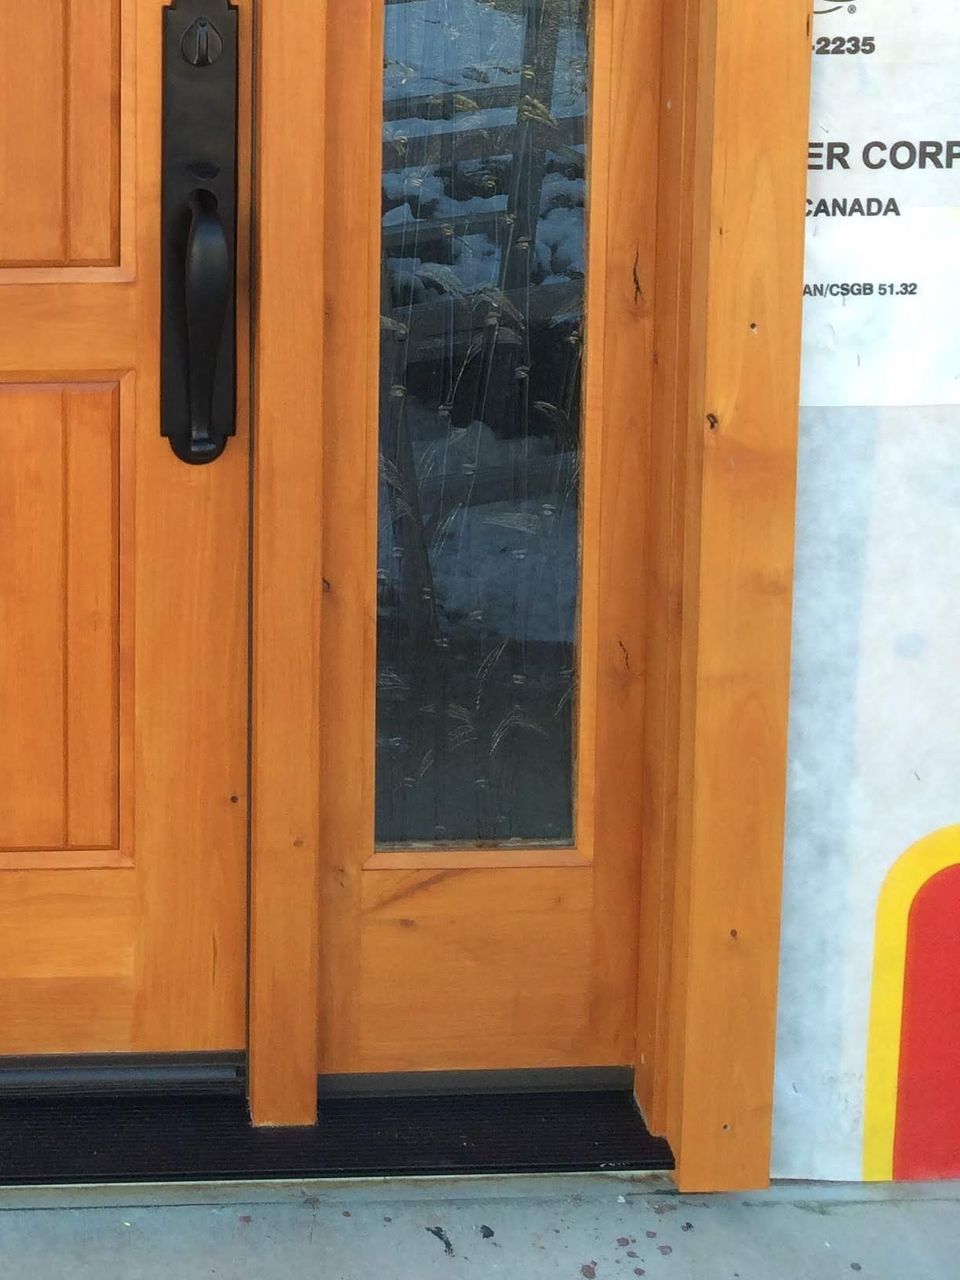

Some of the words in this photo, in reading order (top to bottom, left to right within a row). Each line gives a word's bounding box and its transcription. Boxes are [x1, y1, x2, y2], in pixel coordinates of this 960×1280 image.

[808, 142, 851, 170] ER
[862, 140, 960, 170] CORP
[803, 283, 874, 298] AN/CSGB
[878, 283, 918, 296] 51.32
